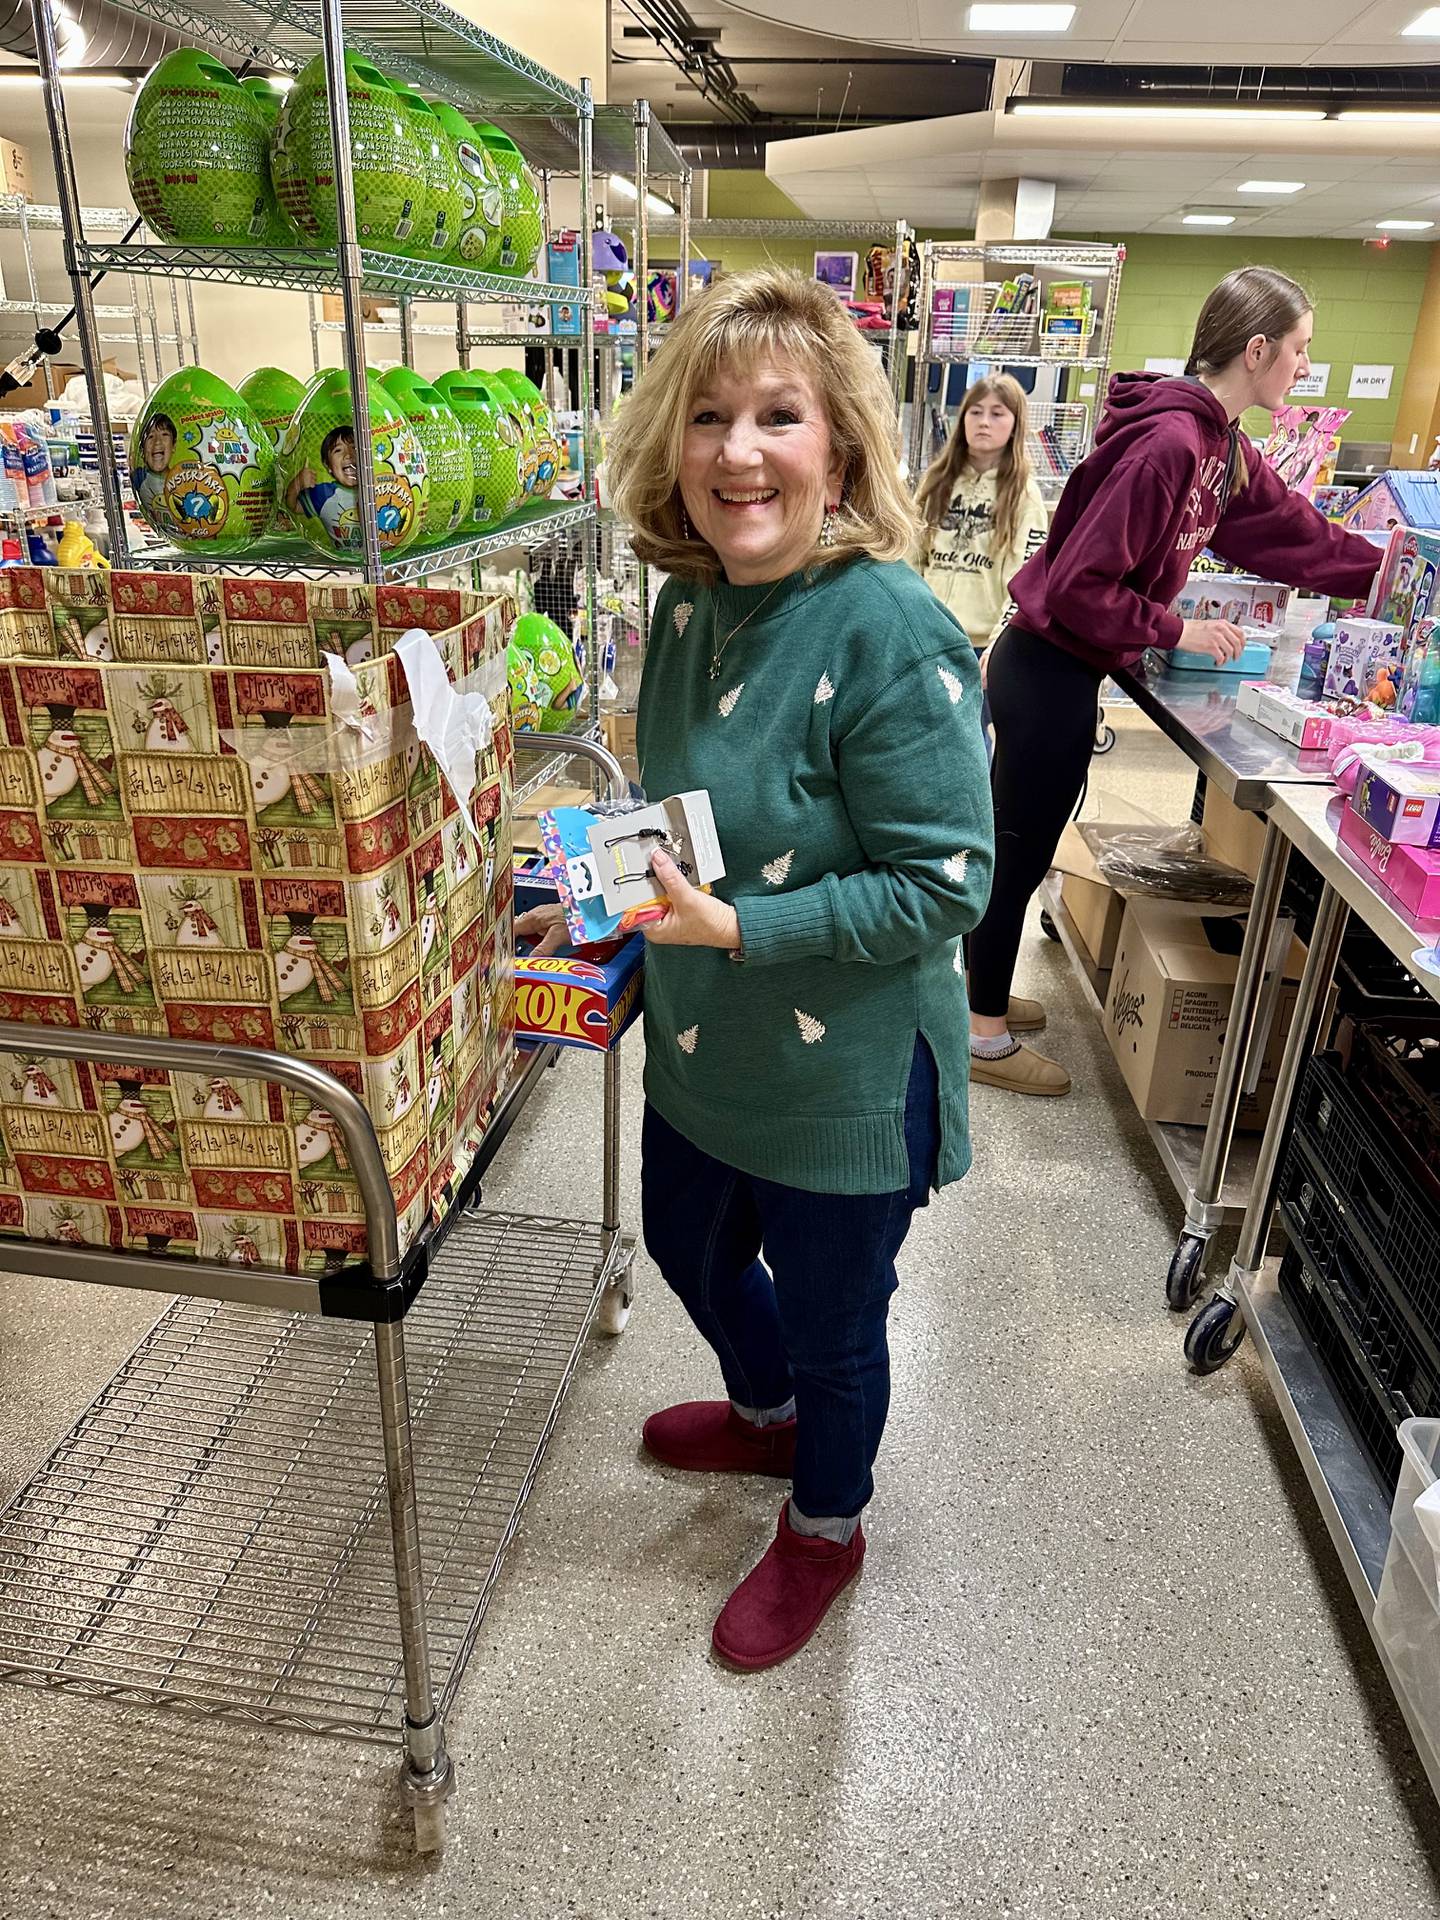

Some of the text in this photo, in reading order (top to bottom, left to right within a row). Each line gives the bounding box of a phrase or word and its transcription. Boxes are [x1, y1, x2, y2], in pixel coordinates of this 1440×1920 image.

[1357, 377, 1386, 385] AIR DRY
[205, 472, 225, 493] ART
[243, 675, 287, 705] Merry
[129, 769, 149, 797] Fa
[147, 765, 167, 793] La
[168, 762, 187, 785] La
[189, 767, 205, 794] La
[1406, 804, 1422, 812] LEGO
[1370, 833, 1393, 873] Barbie
[269, 880, 309, 908] Merry
[160, 963, 179, 987] Fa
[177, 959, 195, 984] La
[197, 956, 216, 977] La
[215, 960, 233, 985] La
[1184, 999, 1219, 1007] SPAGHETTI
[1185, 991, 1208, 999] ACORN
[1182, 1007, 1219, 1016] BUTTERNUT
[1180, 1022, 1211, 1031] DELICATA
[1185, 1069, 1218, 1079] PRODUCT
[8, 1118, 26, 1140] Fa
[24, 1115, 40, 1138] La
[41, 1114, 57, 1132] La
[58, 1118, 73, 1141] La
[188, 1132, 208, 1155] Fa
[205, 1129, 222, 1152] La
[223, 1128, 240, 1145] La
[241, 1131, 255, 1153] La
